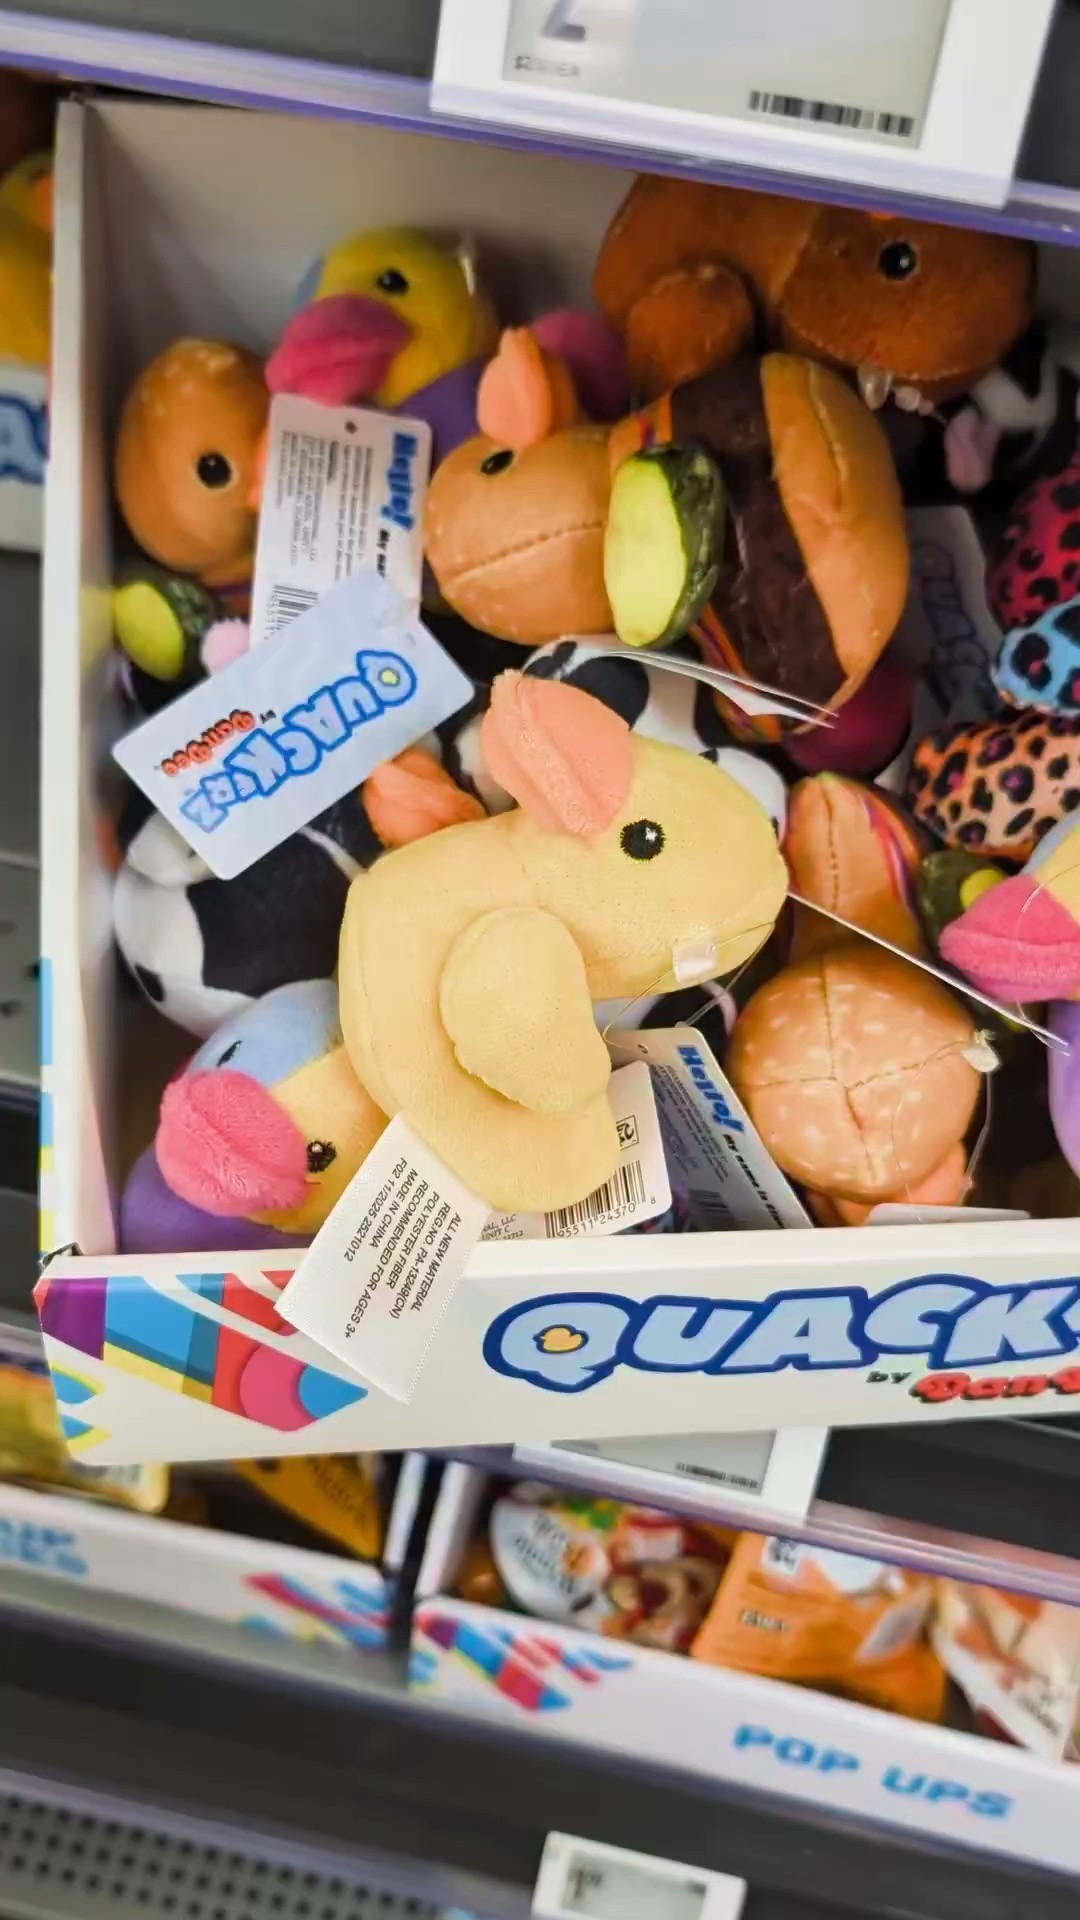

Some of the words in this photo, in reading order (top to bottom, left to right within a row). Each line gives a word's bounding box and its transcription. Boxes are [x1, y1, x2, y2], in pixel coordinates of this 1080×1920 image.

[677, 1046, 744, 1132] Hello!
[391, 1156, 407, 1178] F02
[395, 1168, 417, 1202] MADE
[367, 1178, 395, 1218] 11/2025
[388, 1200, 399, 1214] IN
[599, 1202, 636, 1225] 24370
[343, 1215, 373, 1262] 2521012
[368, 1213, 392, 1249] CHINA
[378, 1179, 428, 1266] RECOMMENDED
[401, 1190, 439, 1255] POLYESTER
[446, 1212, 462, 1234] ALL
[434, 1232, 452, 1261] NEW
[366, 1264, 384, 1291] FOR
[385, 1253, 406, 1289] FIBER
[409, 1259, 439, 1311] MATERIAL
[350, 1289, 371, 1324] AGES
[342, 1323, 356, 1339] 3+
[483, 1273, 1080, 1393] QUACK
[734, 1723, 860, 1772] POP
[881, 1764, 1013, 1818] UPS
